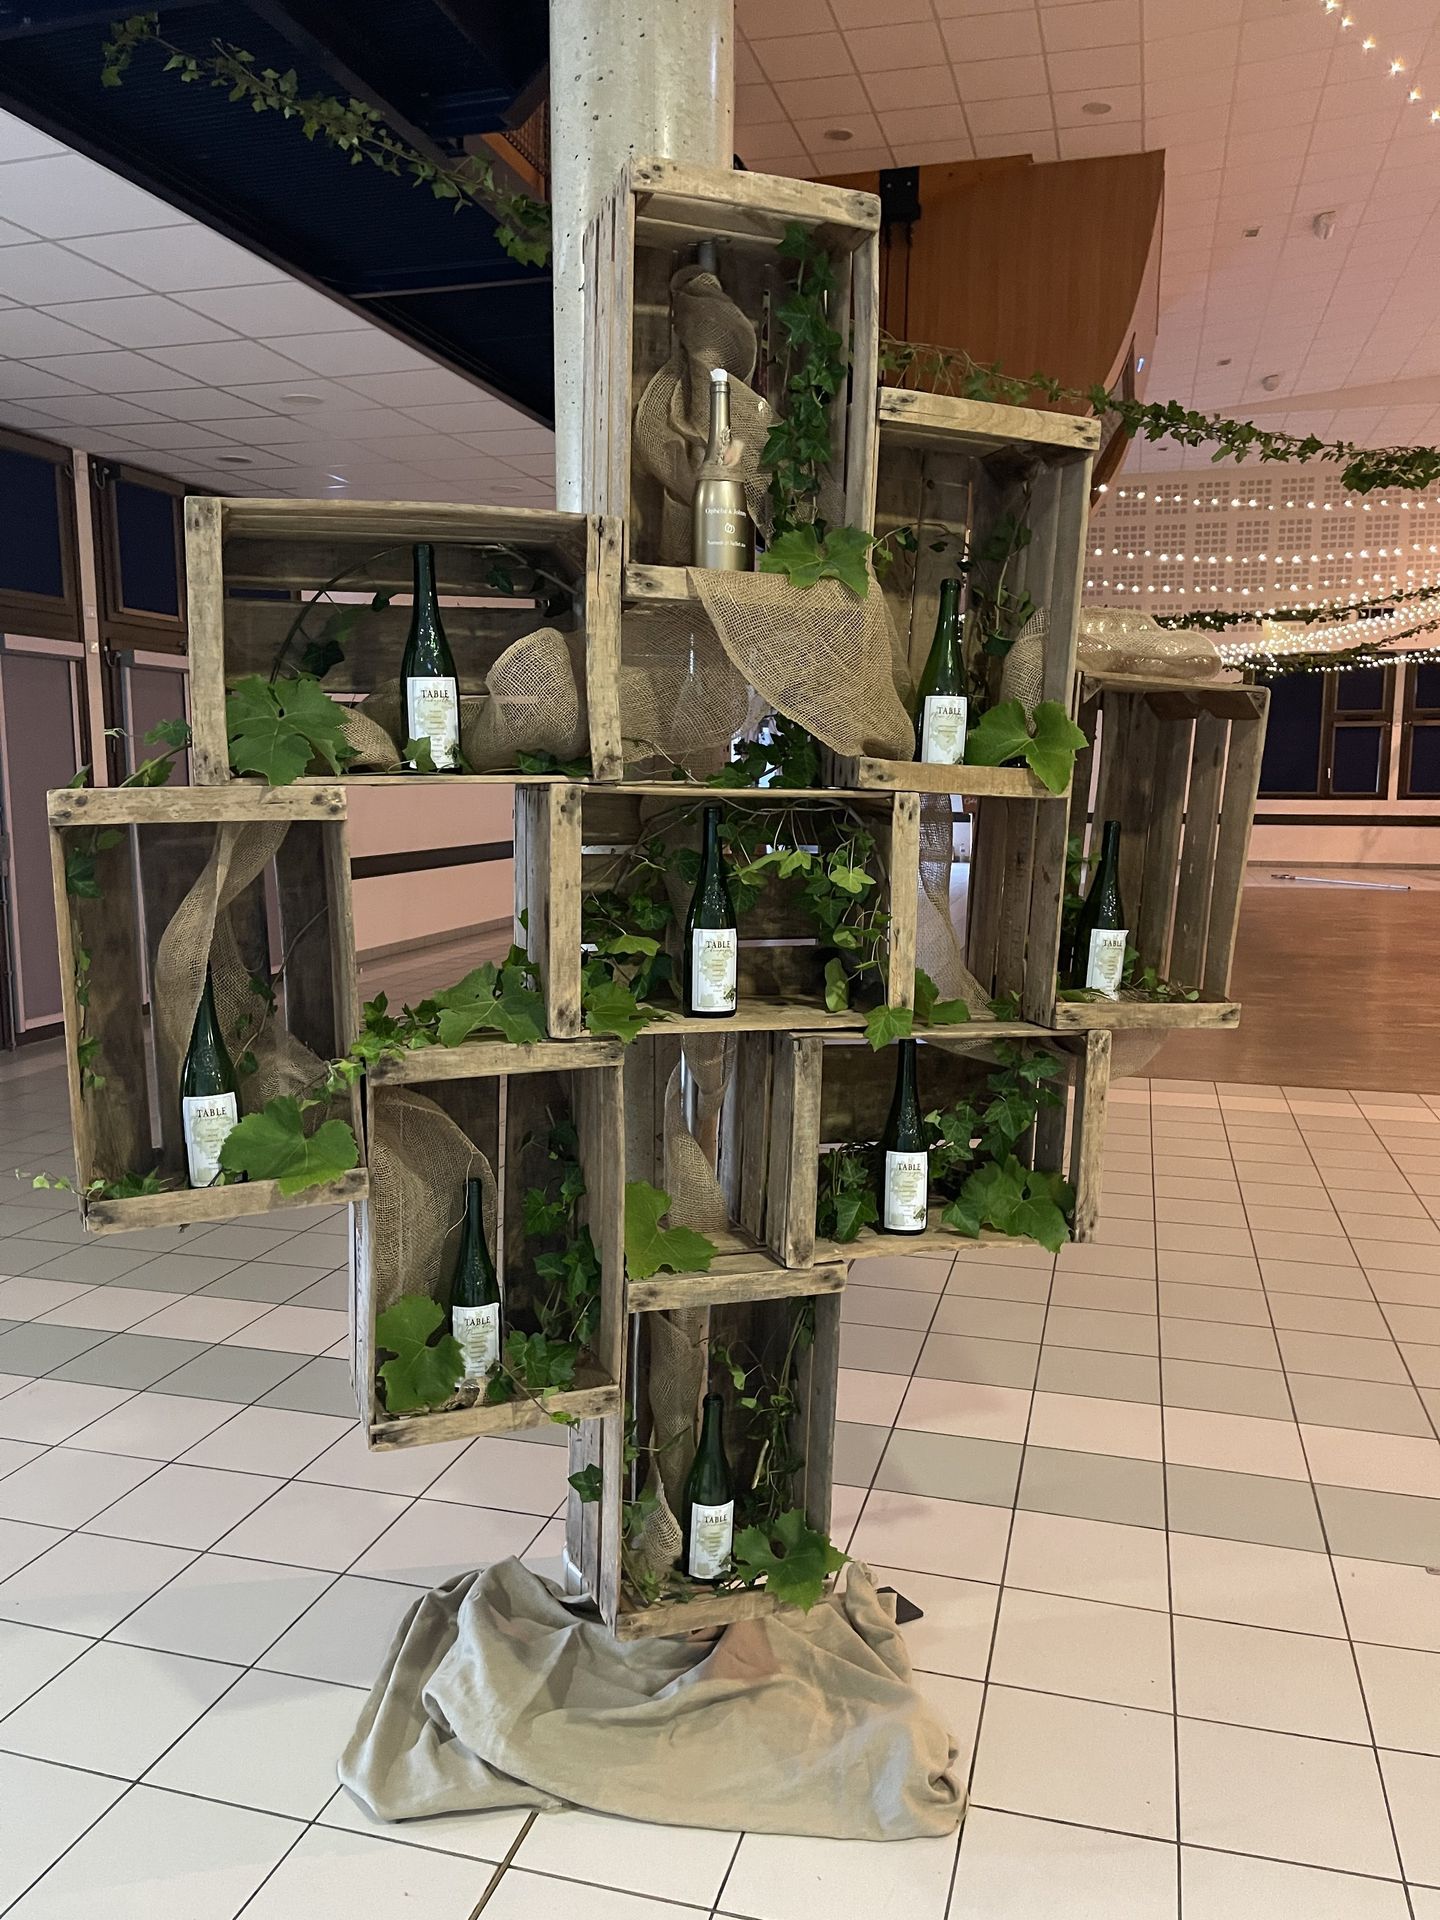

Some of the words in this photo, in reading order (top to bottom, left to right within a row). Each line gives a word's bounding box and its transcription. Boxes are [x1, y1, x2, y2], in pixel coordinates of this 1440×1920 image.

[421, 689, 449, 698] TABLE
[937, 706, 962, 715] TABLE
[706, 940, 731, 948] TABLE
[197, 1107, 227, 1118] TABLE
[898, 1163, 921, 1171] TABLE
[464, 1316, 491, 1326] TABLE
[705, 1514, 727, 1523] TABLE
